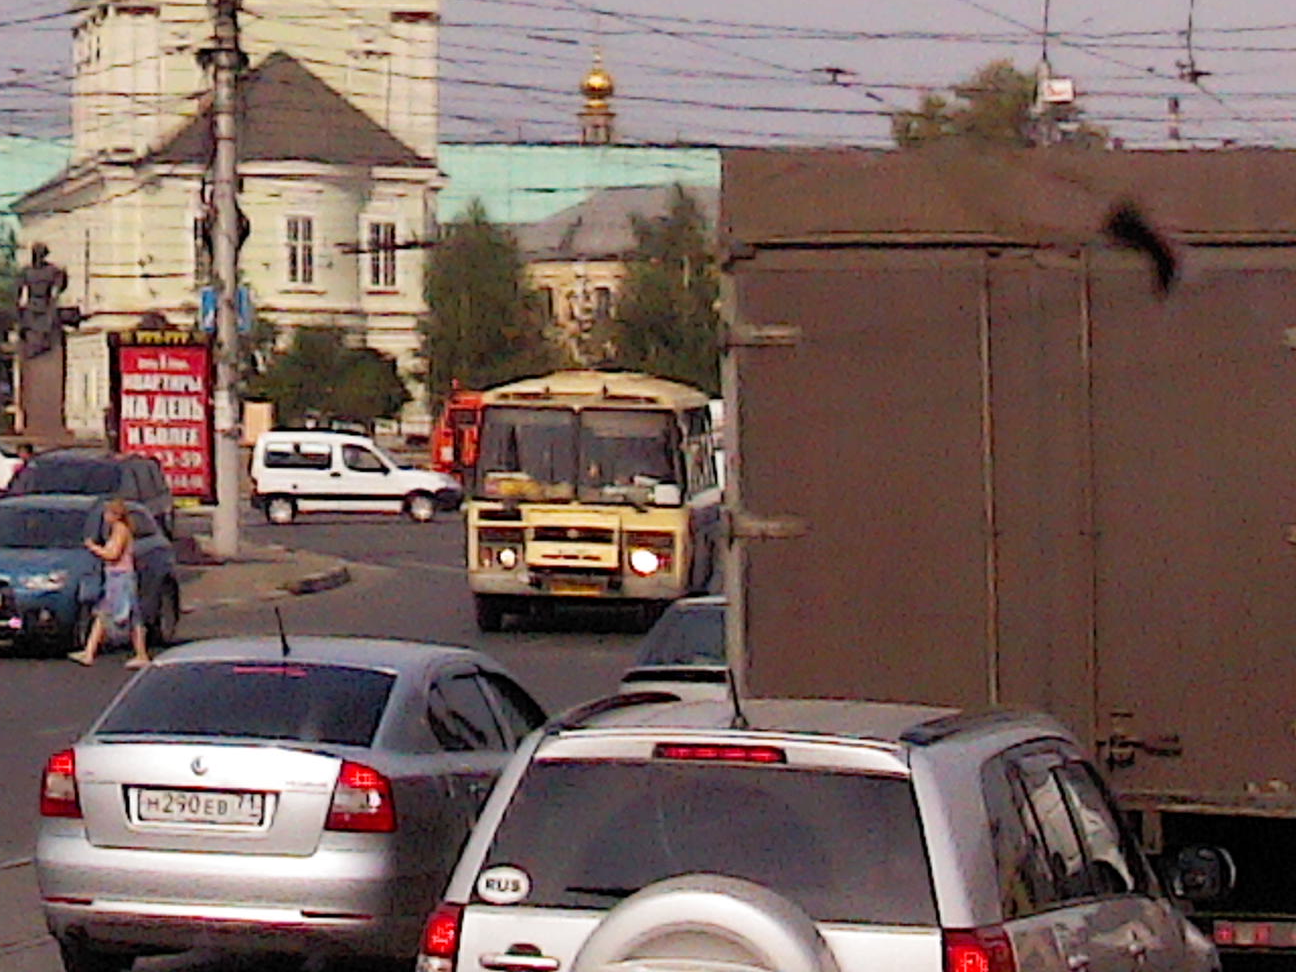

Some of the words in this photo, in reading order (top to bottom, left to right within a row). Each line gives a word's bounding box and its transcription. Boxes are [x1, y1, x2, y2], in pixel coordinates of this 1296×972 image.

[121, 395, 151, 420] НА
[152, 395, 204, 423] ДЕНЬ
[128, 426, 143, 445] И
[485, 878, 521, 892] RUS
